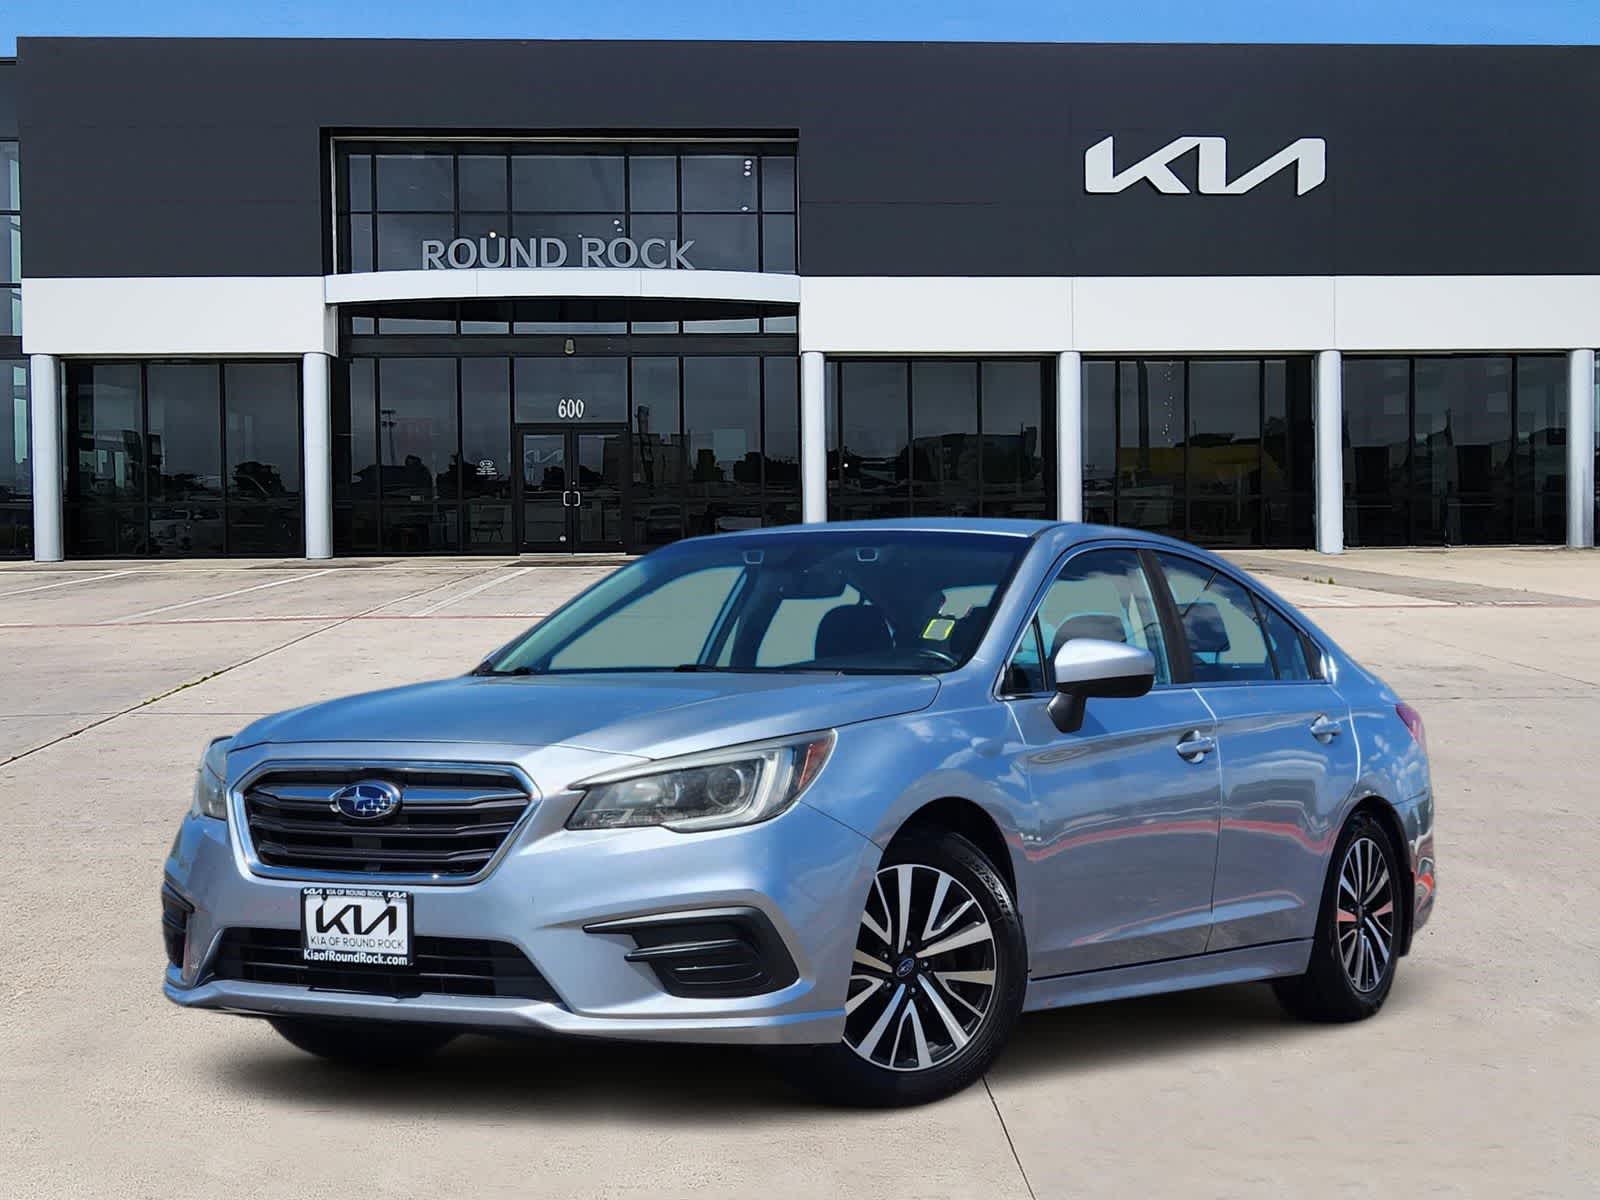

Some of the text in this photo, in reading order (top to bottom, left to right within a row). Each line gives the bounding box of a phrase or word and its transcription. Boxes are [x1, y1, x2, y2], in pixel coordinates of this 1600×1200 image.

[1085, 135, 1326, 196] KIA
[422, 237, 696, 270] ROUND ROCK
[558, 399, 585, 418] 600
[345, 889, 366, 897] ROUND
[315, 904, 398, 936] KIA
[310, 935, 404, 950] KIA OF ROUND ROCK
[303, 948, 408, 966] KiaofRoundRock.com
